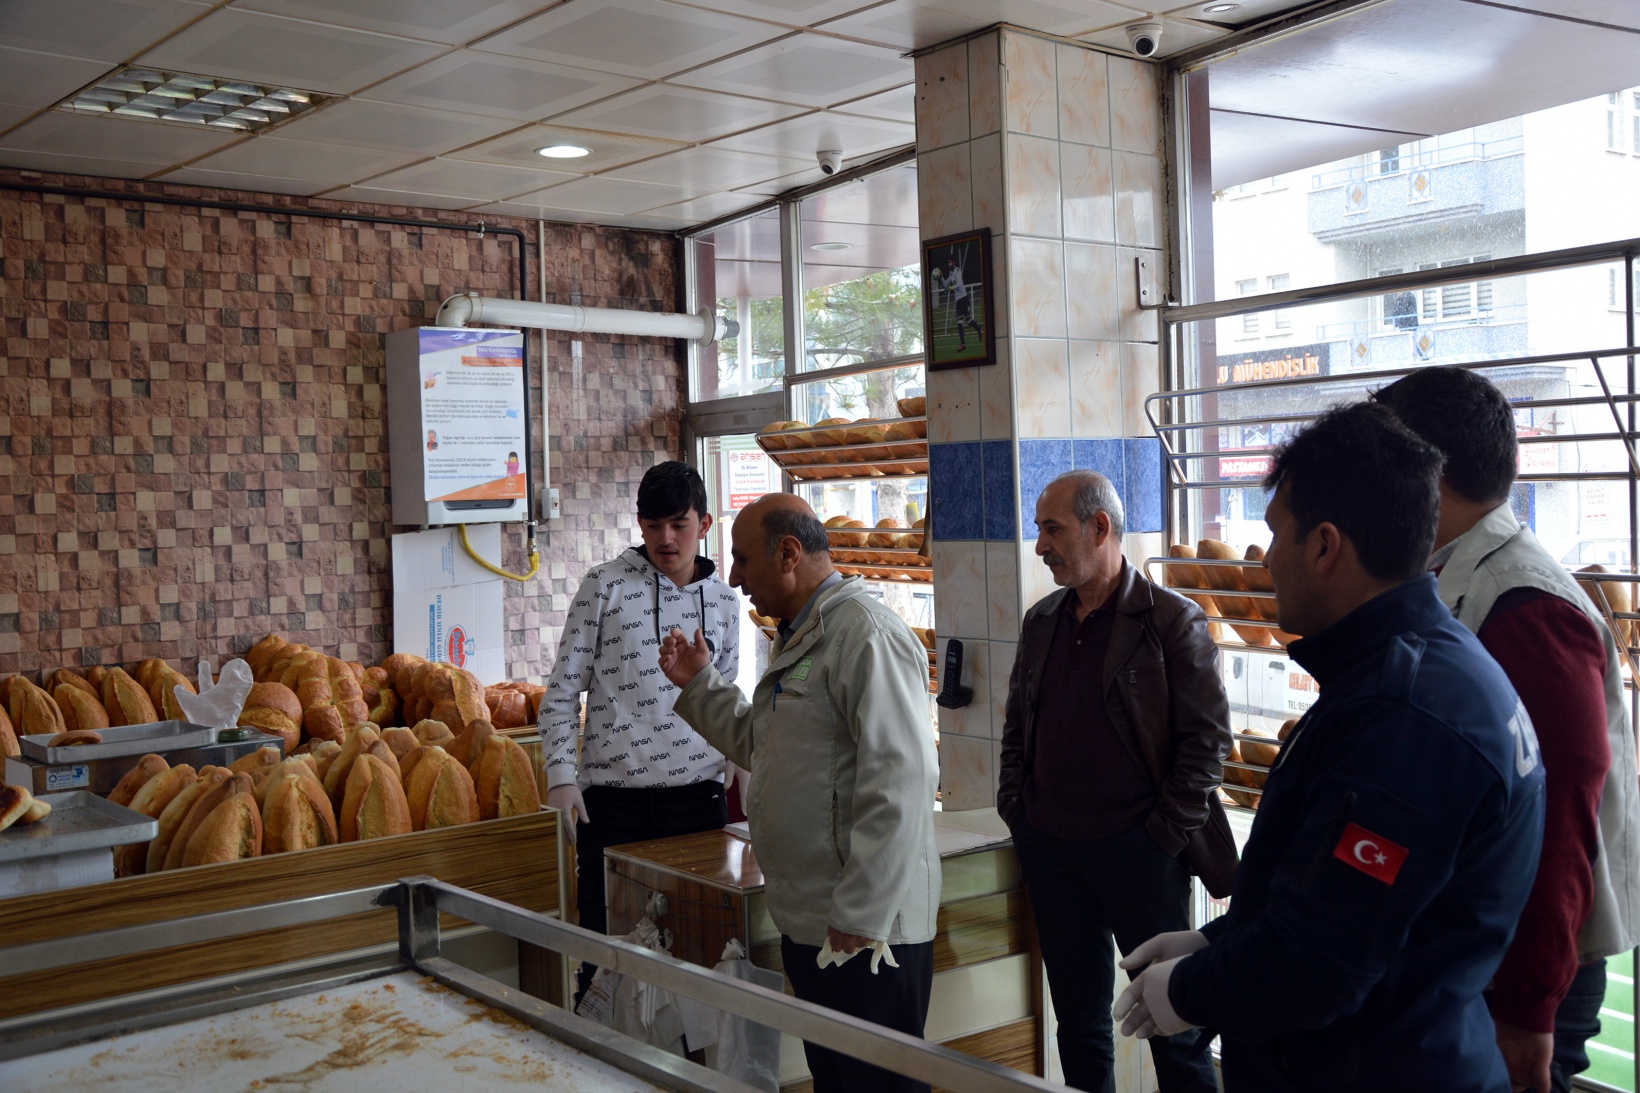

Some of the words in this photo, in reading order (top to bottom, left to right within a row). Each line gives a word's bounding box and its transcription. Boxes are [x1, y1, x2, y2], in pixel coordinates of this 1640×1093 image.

[1217, 366, 1228, 384] U
[1234, 353, 1319, 382] MÜHENDİSLİK
[1222, 461, 1268, 474] PASTANES
[607, 579, 625, 589] NASA
[624, 592, 645, 600] NASA
[603, 607, 623, 618] NASA
[622, 621, 643, 630] NASA
[604, 636, 622, 646] NASA
[621, 652, 641, 661] NASA
[602, 667, 620, 675] NASA
[640, 668, 660, 676] NASA
[619, 683, 638, 691] NASA
[638, 698, 658, 707] NASA
[612, 724, 633, 733] NASA
[654, 723, 674, 732] NASA
[632, 738, 652, 747] NASA
[673, 738, 691, 747] NASA
[610, 754, 629, 762] NASA
[650, 753, 670, 762] NASA
[689, 753, 708, 761] NASA
[627, 767, 648, 776] NASA
[669, 767, 688, 776] NASA
